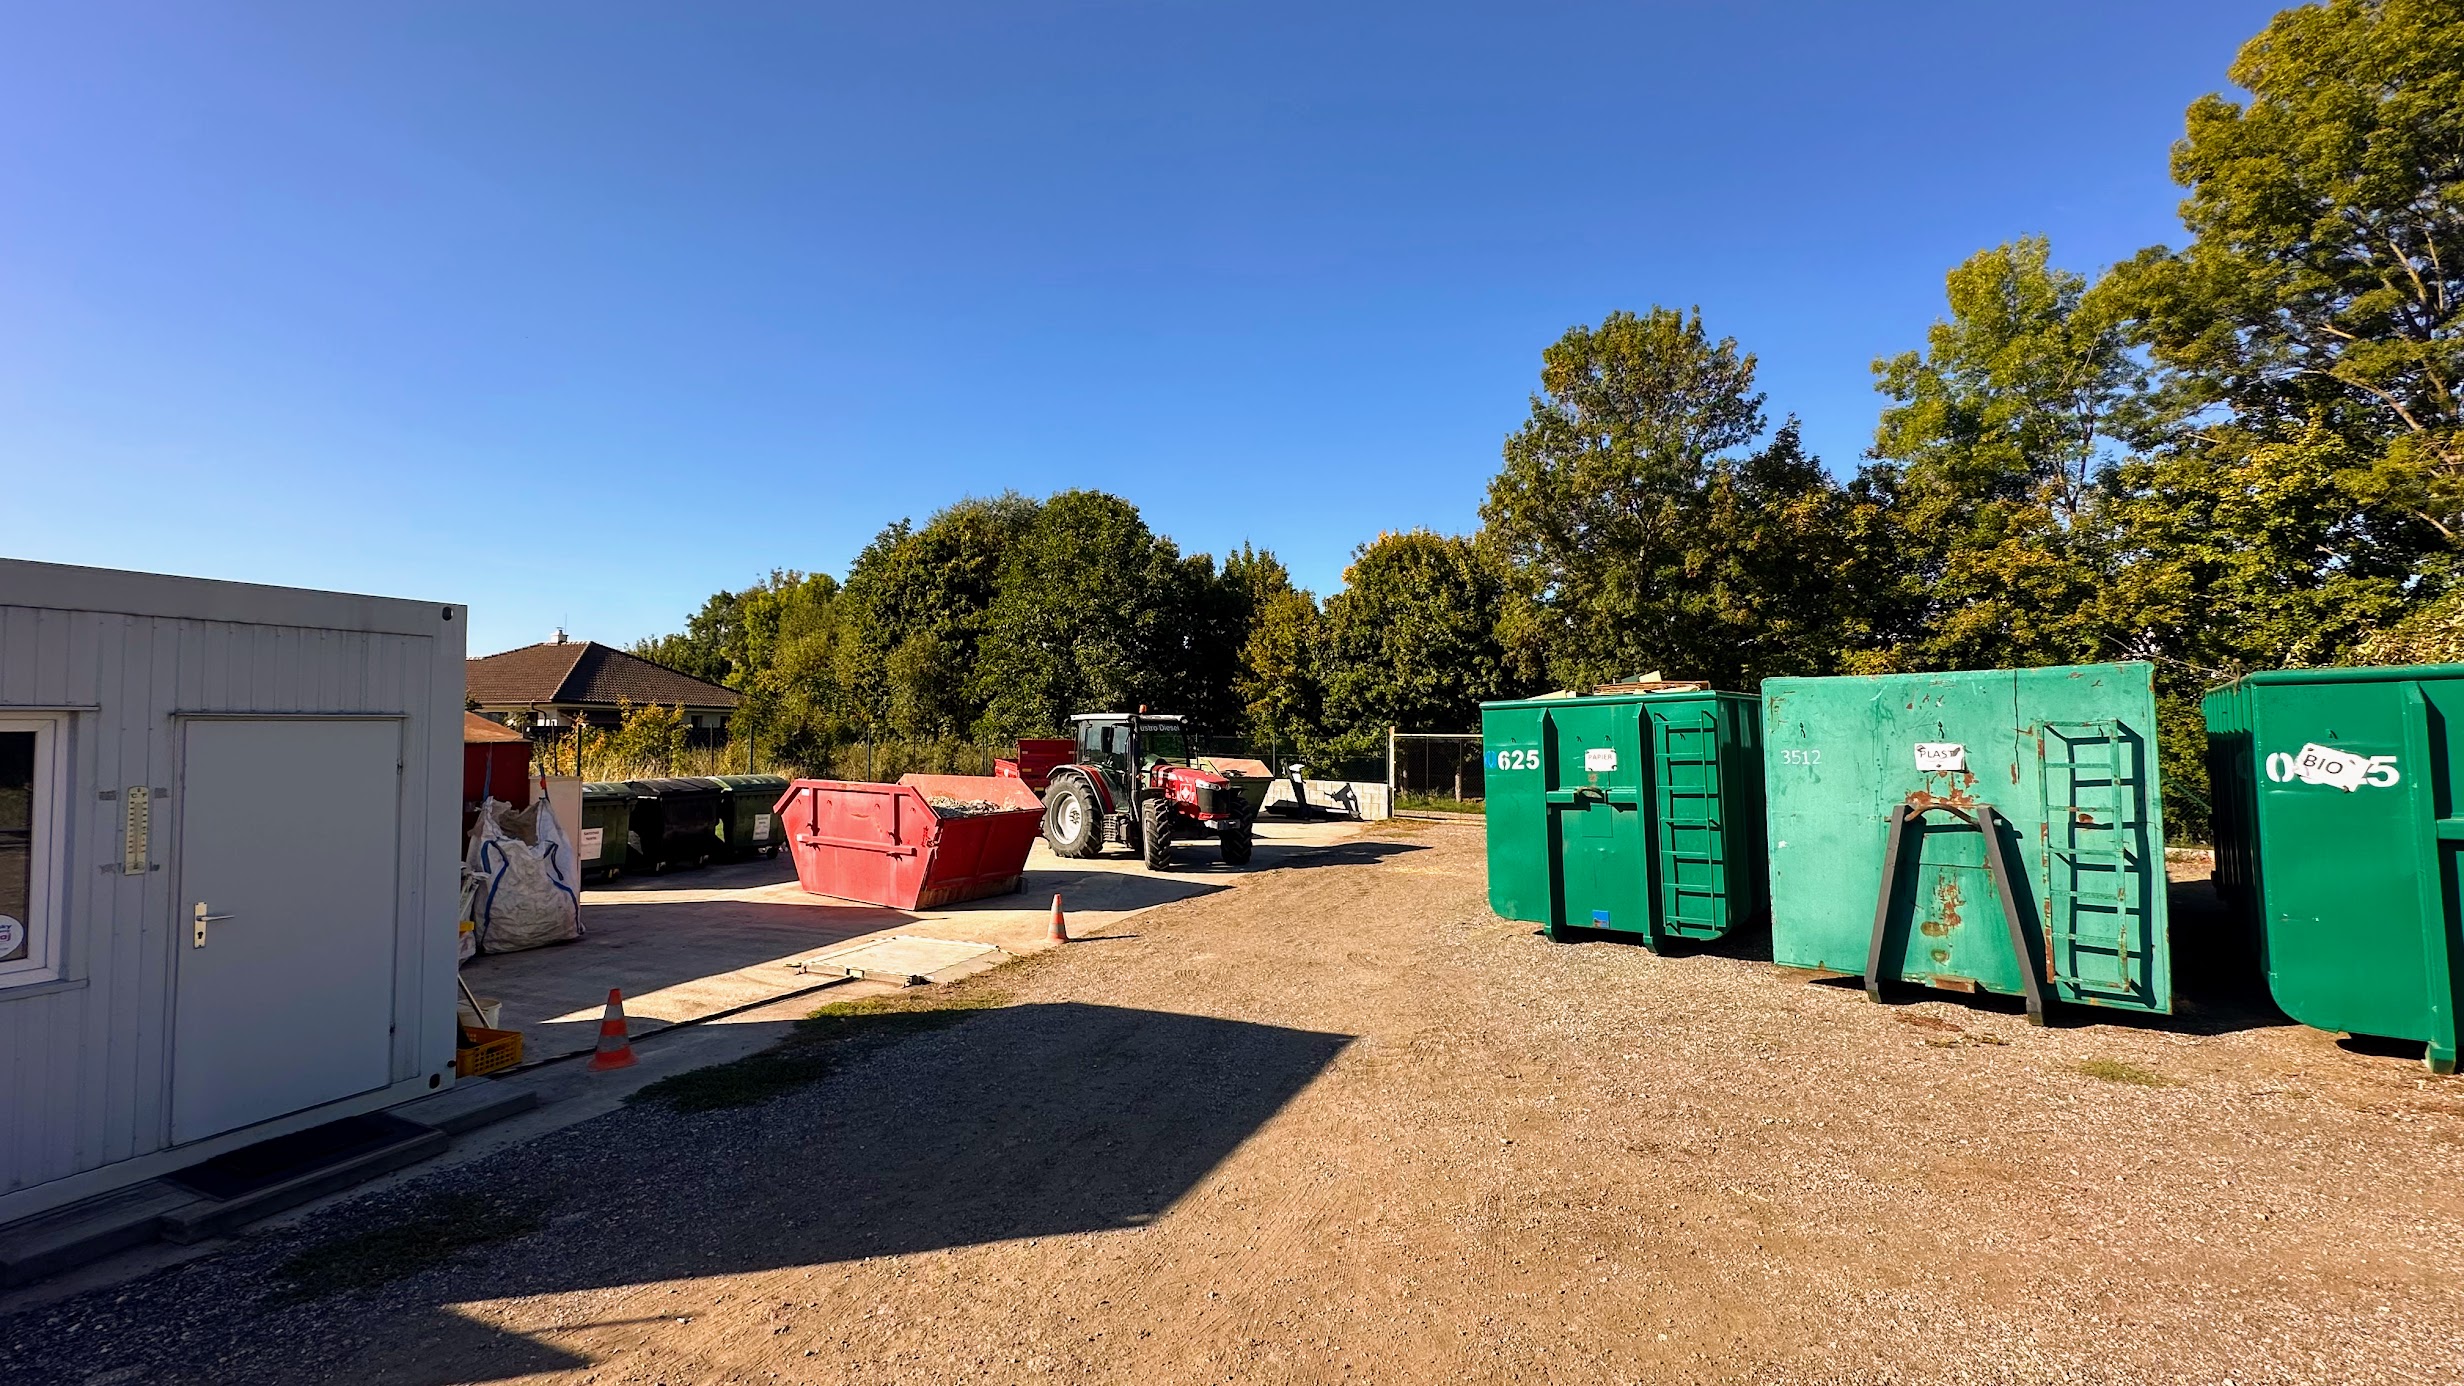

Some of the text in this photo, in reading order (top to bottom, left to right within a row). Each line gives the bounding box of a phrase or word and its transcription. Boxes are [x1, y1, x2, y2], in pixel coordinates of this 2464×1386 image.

[1140, 723, 1180, 732] ustro Diesel
[1780, 749, 1823, 765] 3512
[2302, 753, 2343, 775] BIO
[2265, 751, 2400, 788] 05
